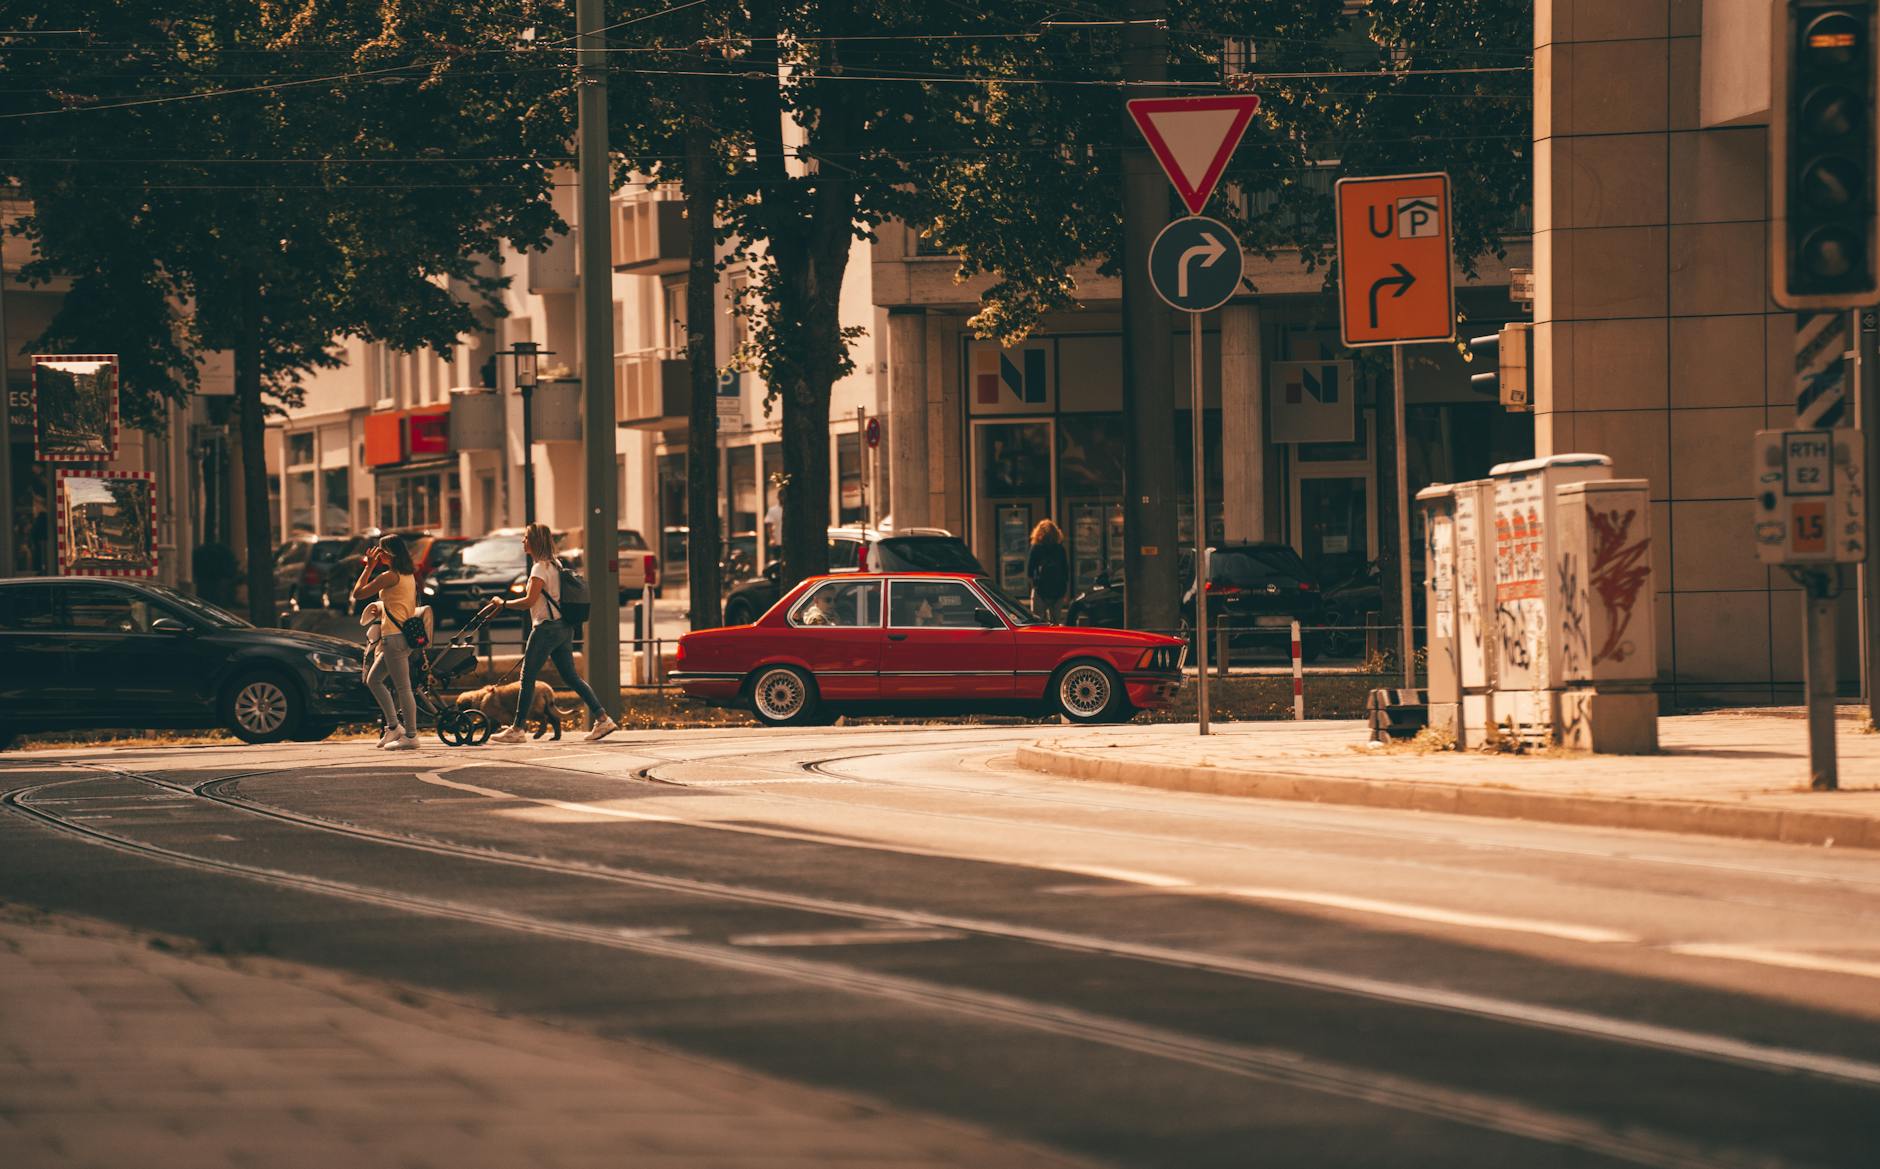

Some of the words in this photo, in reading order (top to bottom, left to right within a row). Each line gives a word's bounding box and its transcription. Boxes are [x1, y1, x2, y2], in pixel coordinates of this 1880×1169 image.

[1369, 204, 1393, 238] U
[1411, 210, 1429, 235] P
[1791, 442, 1826, 458] RTH
[1797, 467, 1819, 483] E2
